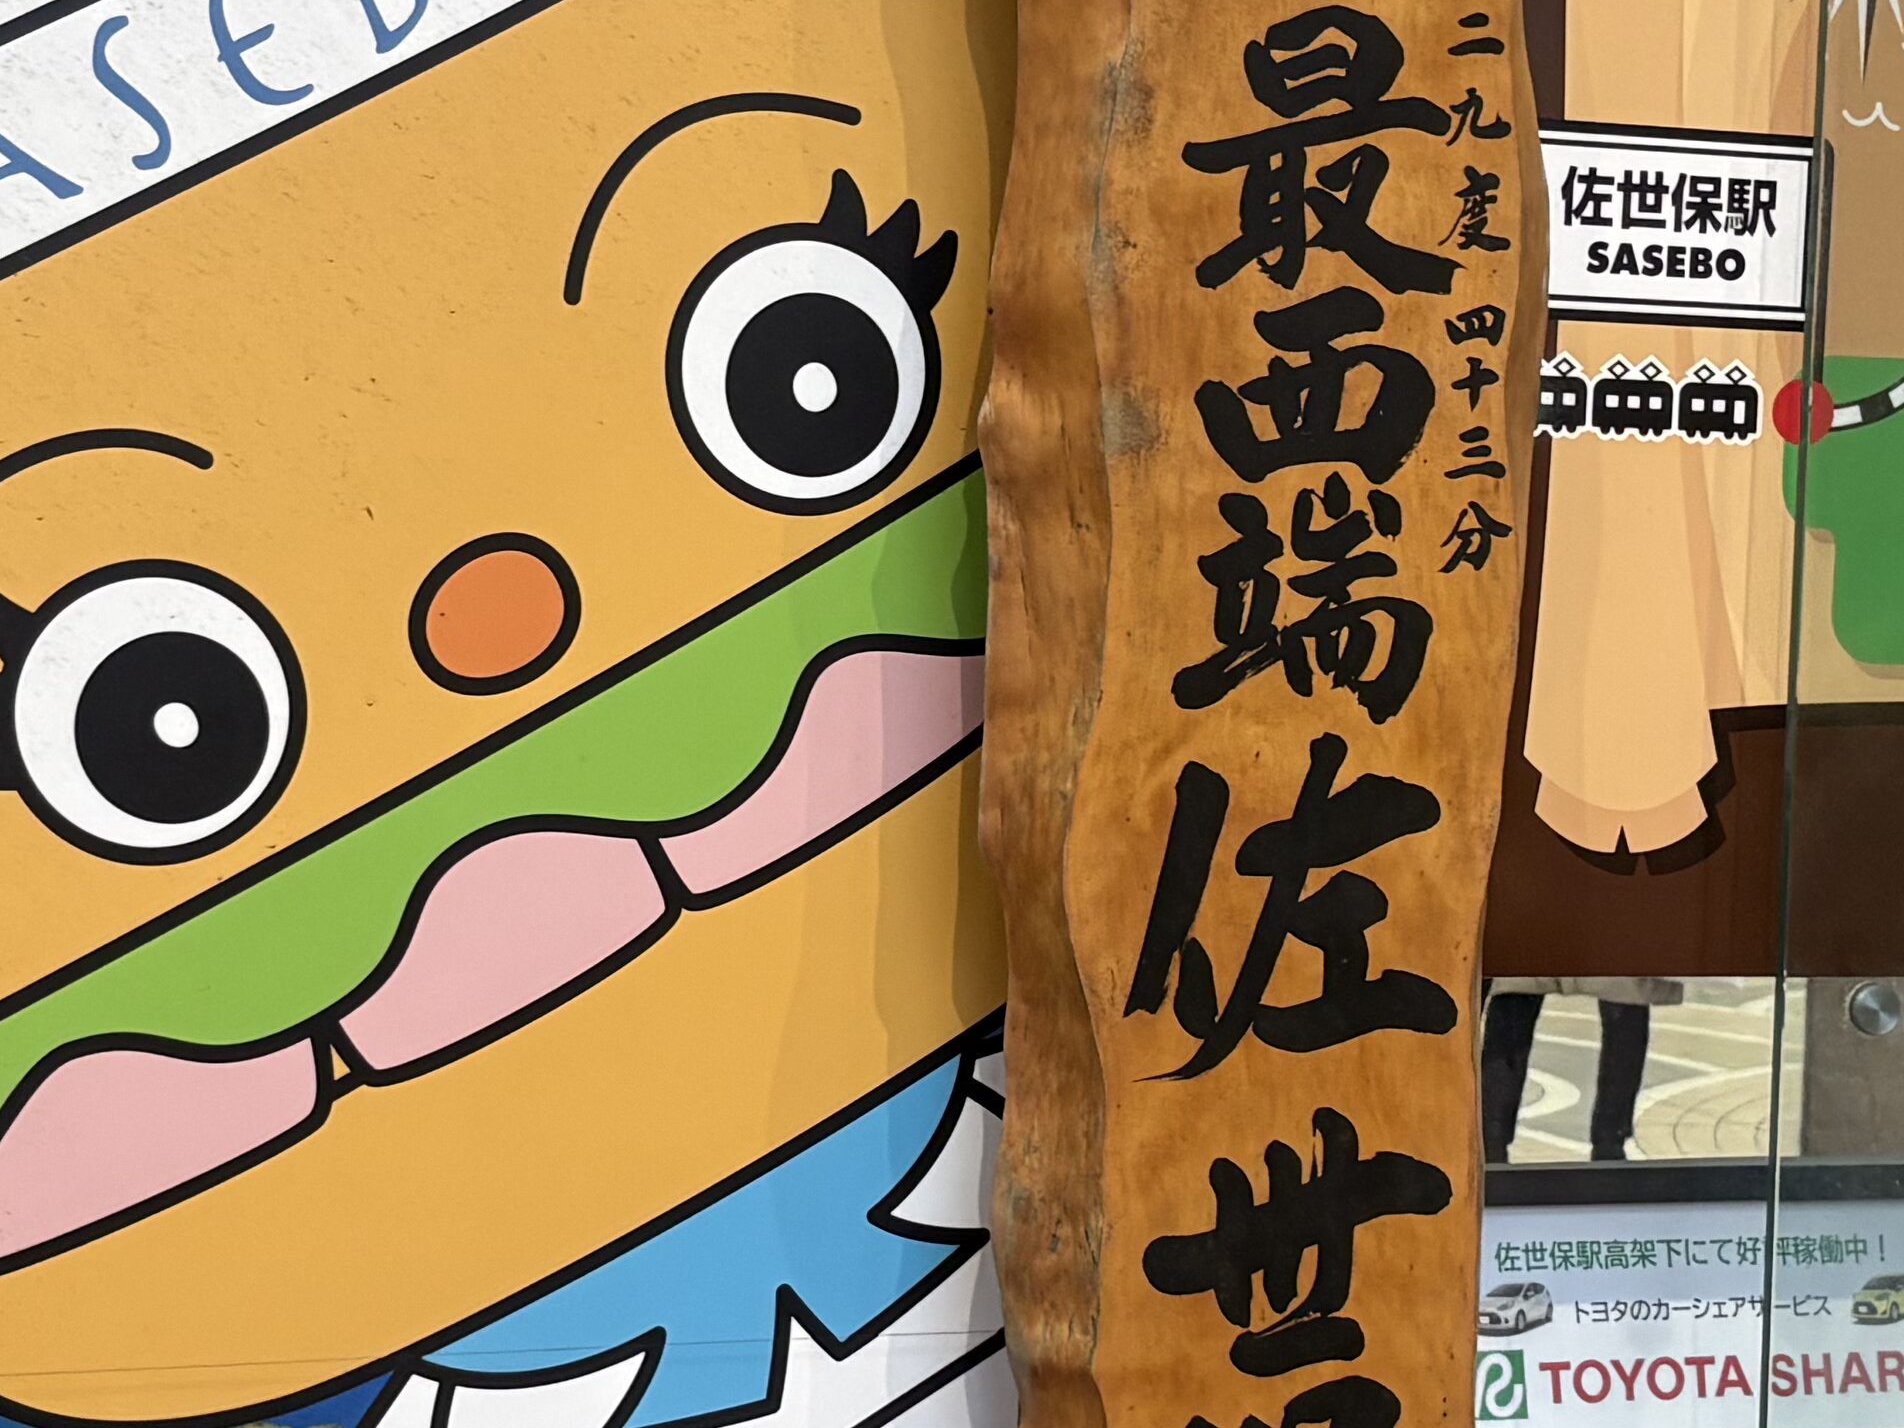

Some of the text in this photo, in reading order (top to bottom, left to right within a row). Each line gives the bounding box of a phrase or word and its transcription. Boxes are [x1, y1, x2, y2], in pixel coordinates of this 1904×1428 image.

[1561, 165, 1778, 238] 佐世保駅
[1587, 241, 1746, 281] SASEBO
[1538, 1354, 1754, 1405] TOYOTA
